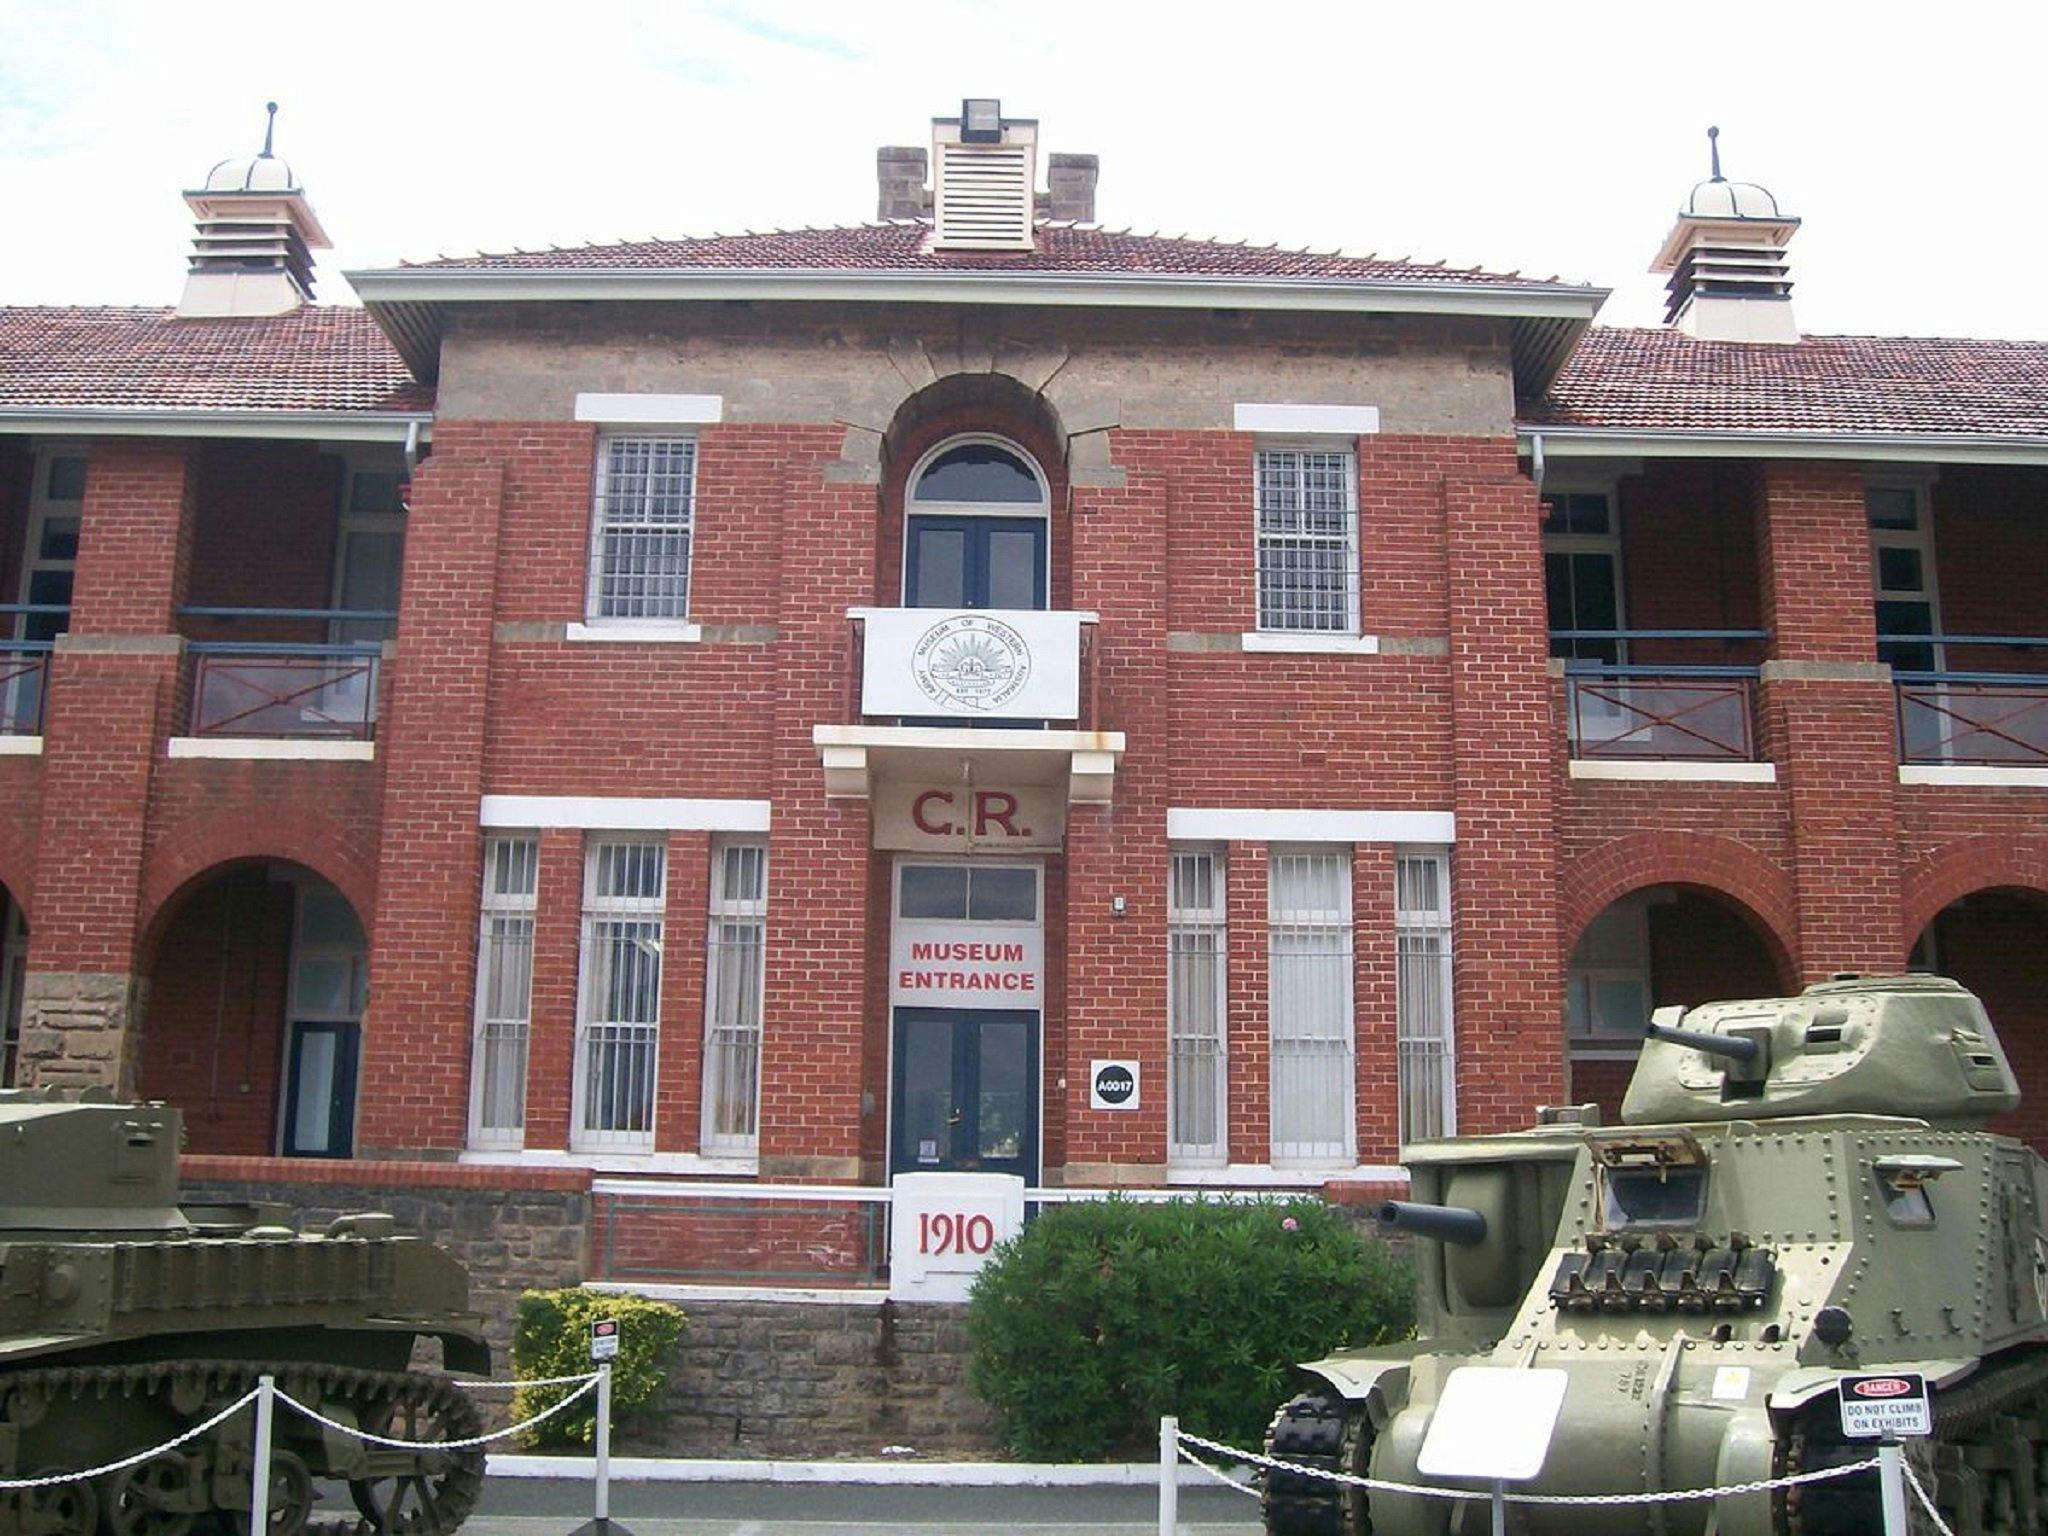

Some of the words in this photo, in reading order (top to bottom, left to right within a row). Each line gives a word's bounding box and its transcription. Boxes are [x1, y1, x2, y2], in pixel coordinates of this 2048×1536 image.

[961, 619, 973, 627] OF
[917, 624, 951, 656] MUSEUM
[987, 622, 1025, 656] WESTERN
[918, 670, 937, 695] ARMY
[992, 664, 1027, 704] AUSTRALIA
[911, 943, 1024, 962] MUSEUM
[898, 971, 1036, 991] ENTRANCE
[1097, 1080, 1133, 1092] A0017
[919, 1212, 994, 1257] 1910
[1864, 1381, 1900, 1393] DANGER
[1847, 1405, 1862, 1416] DO
[1864, 1404, 1885, 1414] NOT
[1888, 1402, 1922, 1414] CLIMB
[1853, 1419, 1868, 1429] ON
[1871, 1417, 1919, 1428] EXHIBITS
